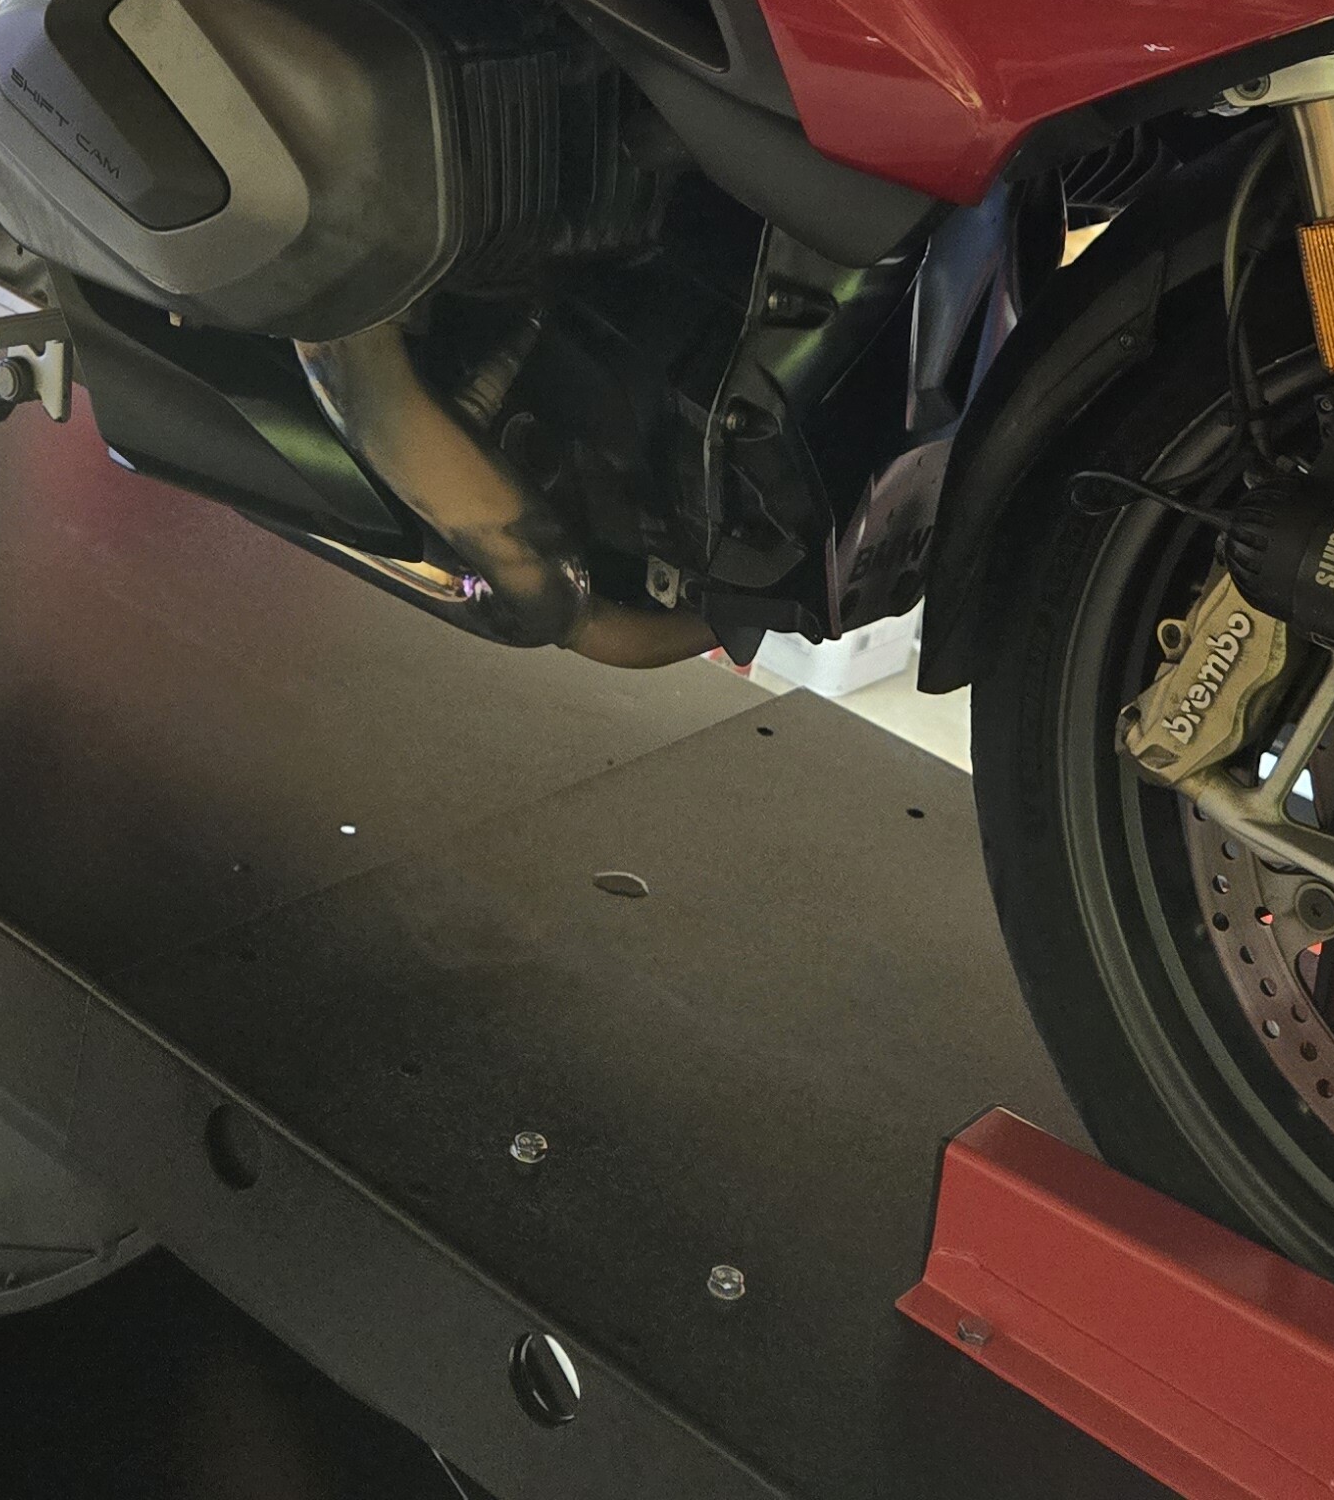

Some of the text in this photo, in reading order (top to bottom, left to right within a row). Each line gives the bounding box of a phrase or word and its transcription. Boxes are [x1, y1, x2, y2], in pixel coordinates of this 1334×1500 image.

[10, 67, 121, 179] SHIFT CAM
[1162, 611, 1254, 745] brembo
